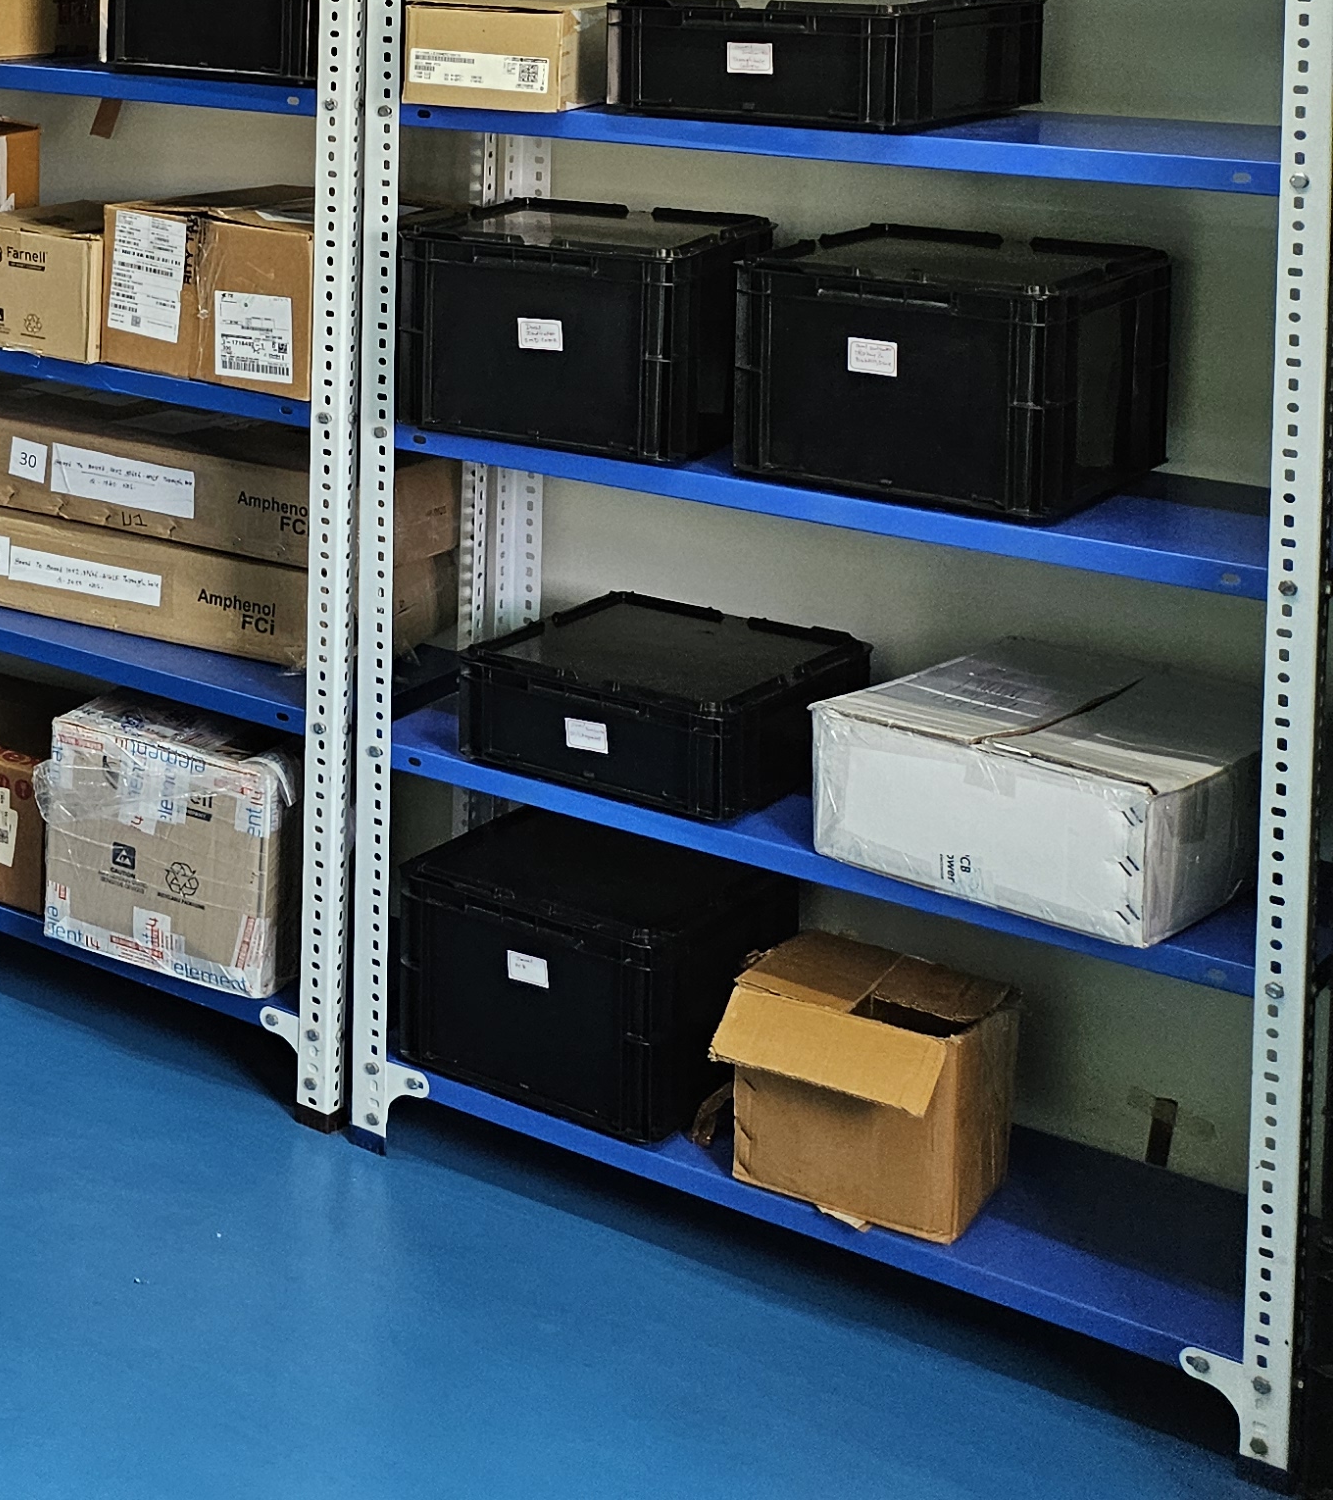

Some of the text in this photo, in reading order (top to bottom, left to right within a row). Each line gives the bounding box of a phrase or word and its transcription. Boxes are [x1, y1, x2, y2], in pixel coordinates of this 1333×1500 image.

[7, 246, 46, 264] Farnell
[19, 451, 37, 469] 30
[237, 490, 309, 517] Ampheno
[198, 588, 276, 618] Amphenol
[241, 615, 275, 636] FCi
[946, 854, 956, 882] ower
[960, 854, 971, 874] CB
[173, 961, 247, 992] element
